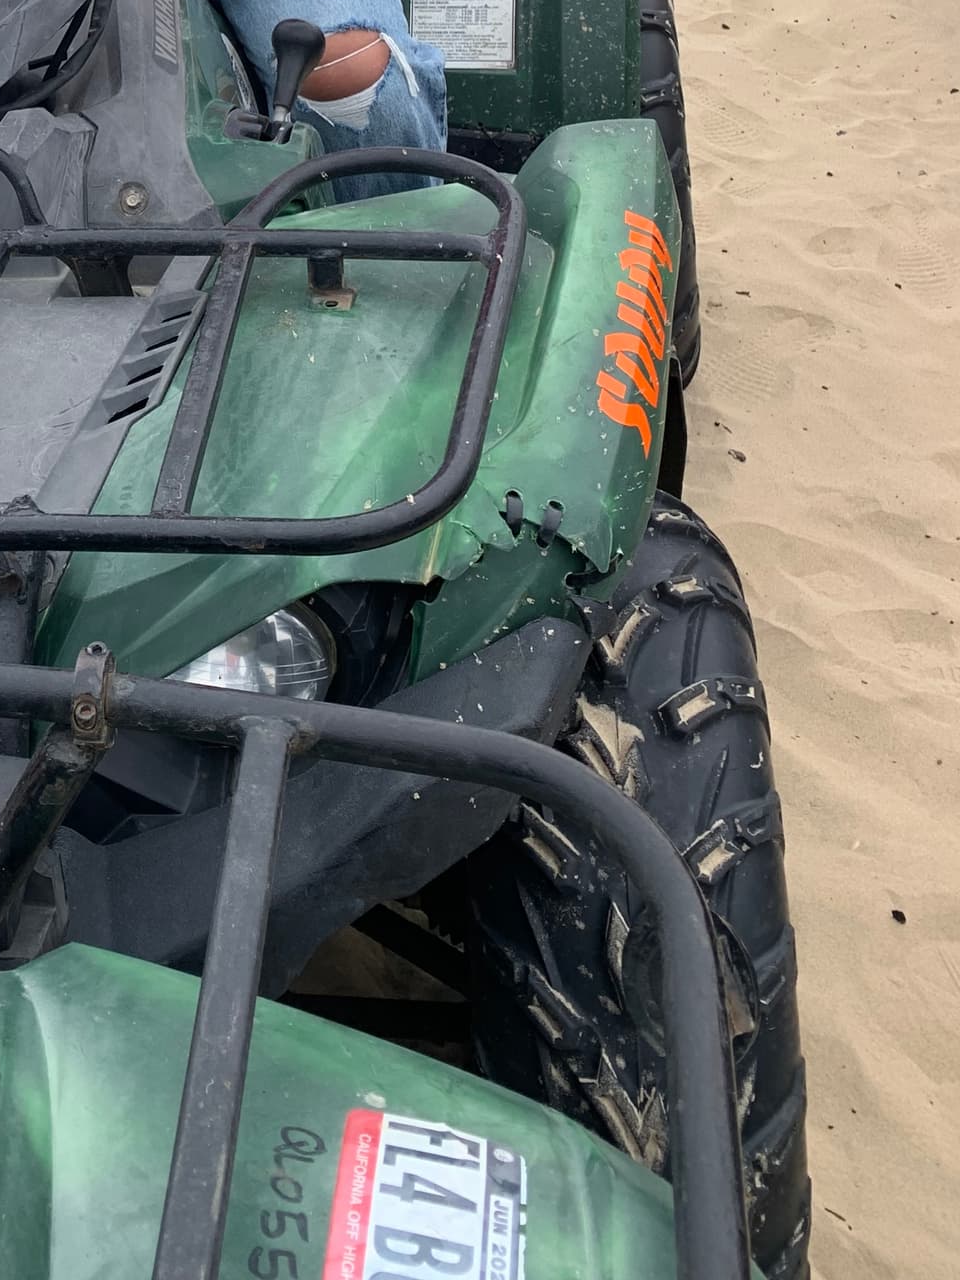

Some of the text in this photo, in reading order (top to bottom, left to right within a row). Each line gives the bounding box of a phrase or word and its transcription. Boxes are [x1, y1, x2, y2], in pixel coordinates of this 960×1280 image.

[350, 1133, 372, 1206] CALIFORNIA
[346, 1210, 361, 1241] OFF
[493, 1200, 510, 1235] JUN
